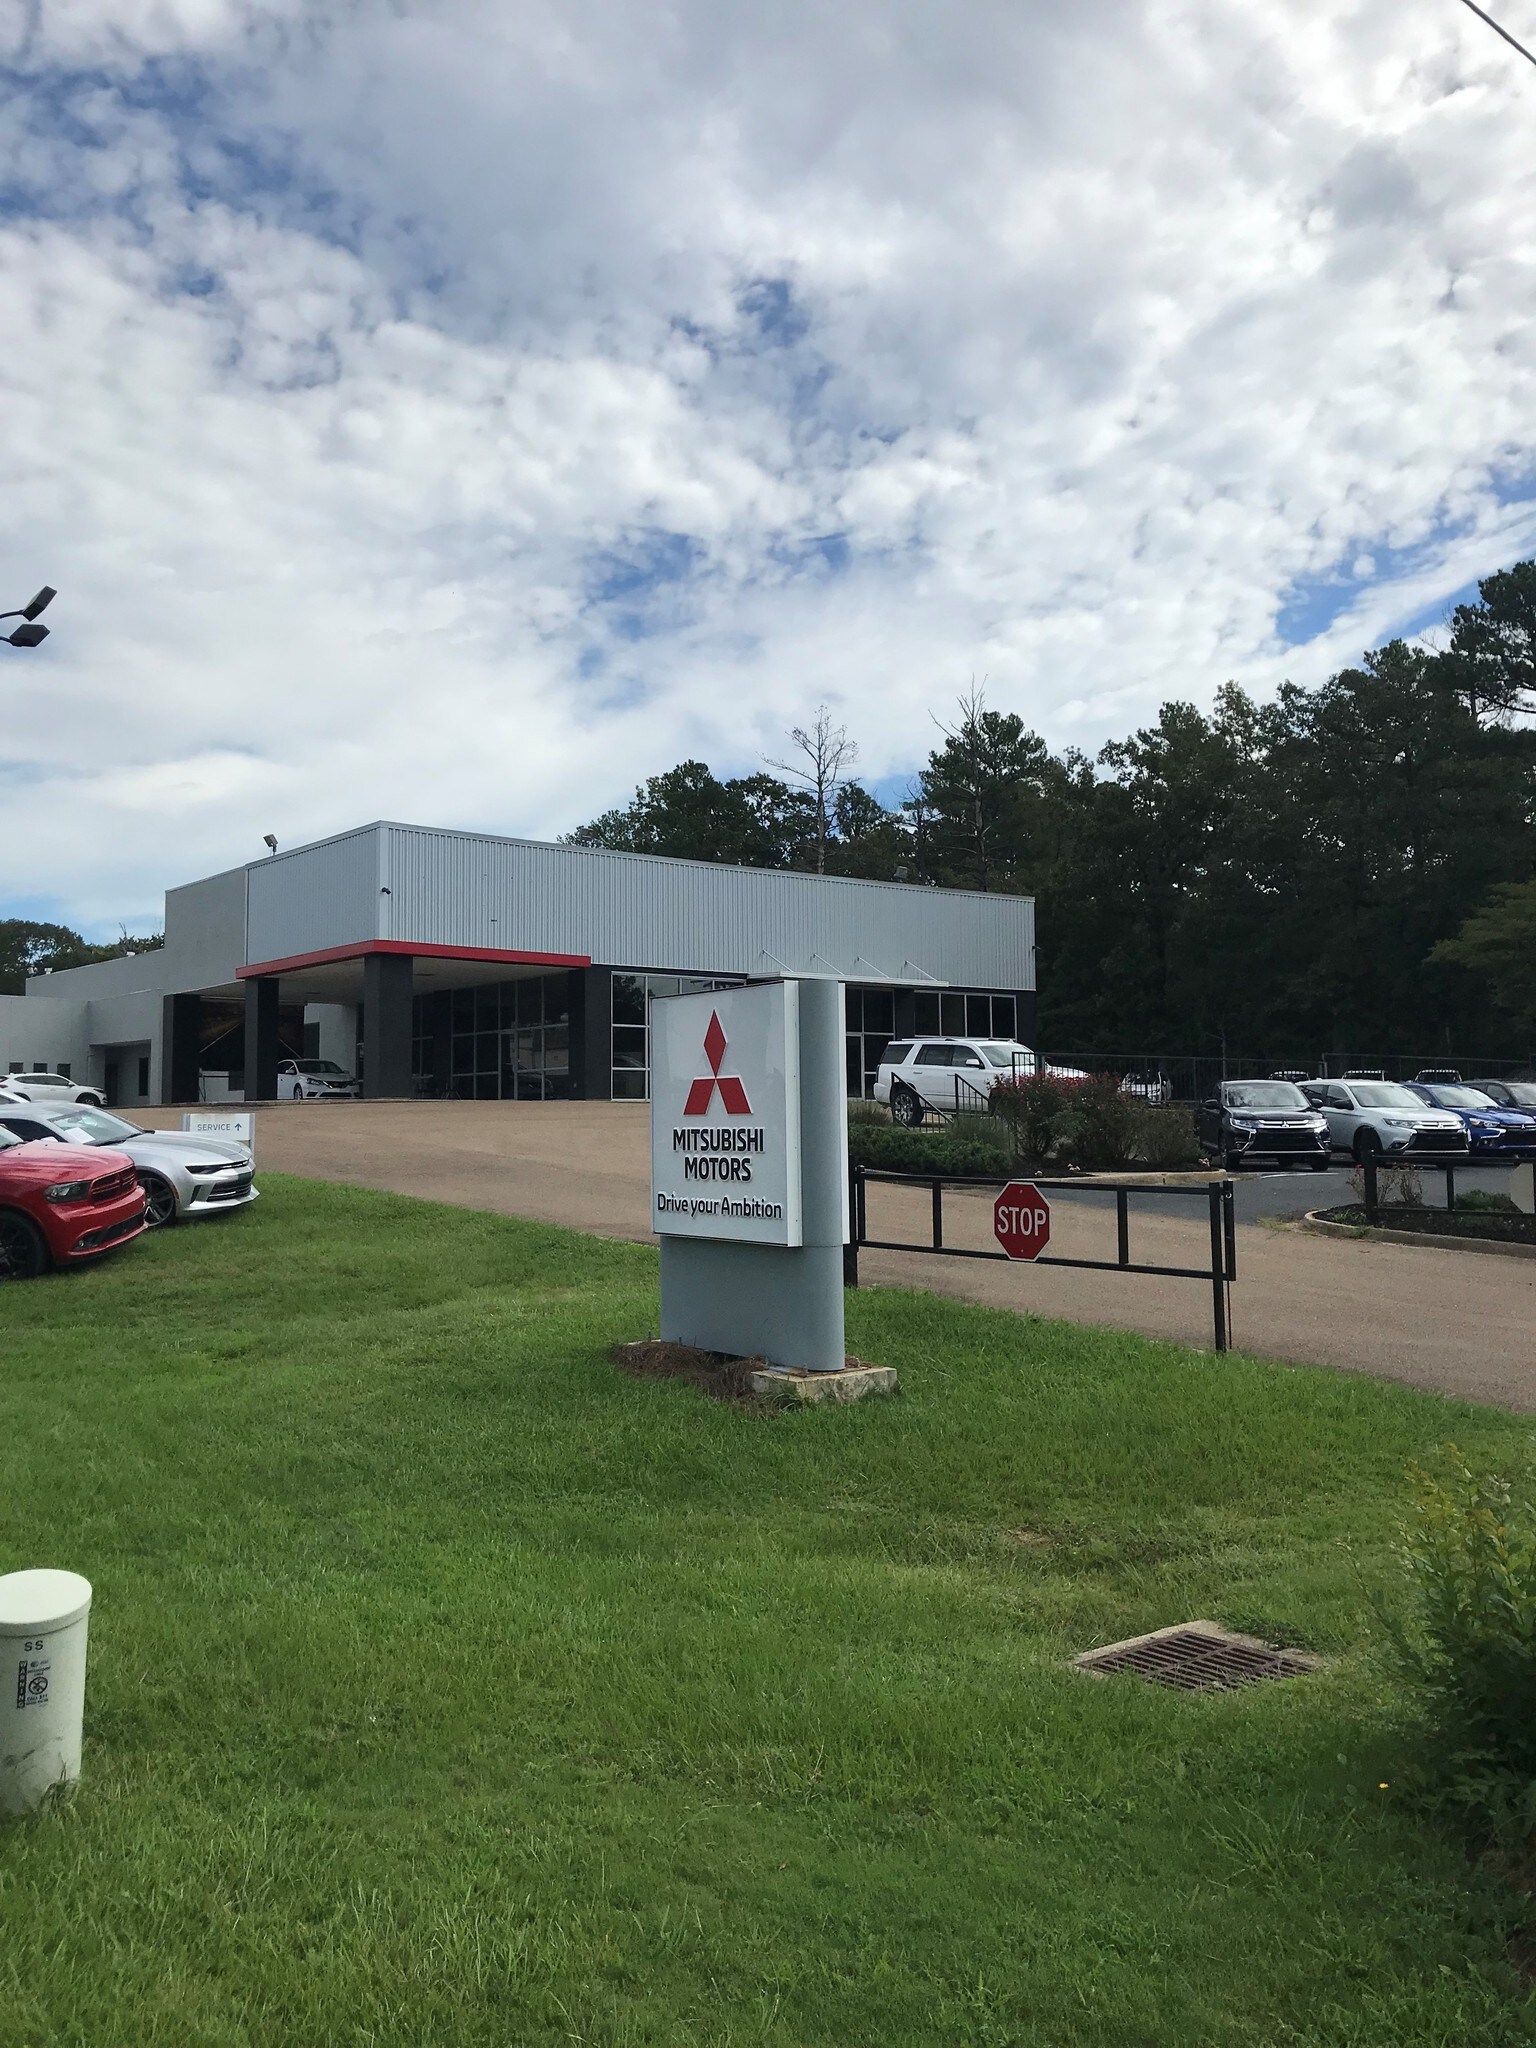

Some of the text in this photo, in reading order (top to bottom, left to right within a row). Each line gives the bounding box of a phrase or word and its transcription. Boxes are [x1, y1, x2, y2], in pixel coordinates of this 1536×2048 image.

[197, 1123, 231, 1131] SERVICE
[672, 1127, 764, 1152] MITSUBISHI
[684, 1156, 752, 1181] MOTORS
[657, 1193, 782, 1219] Drive your Ambition
[997, 1205, 1047, 1236] STOP
